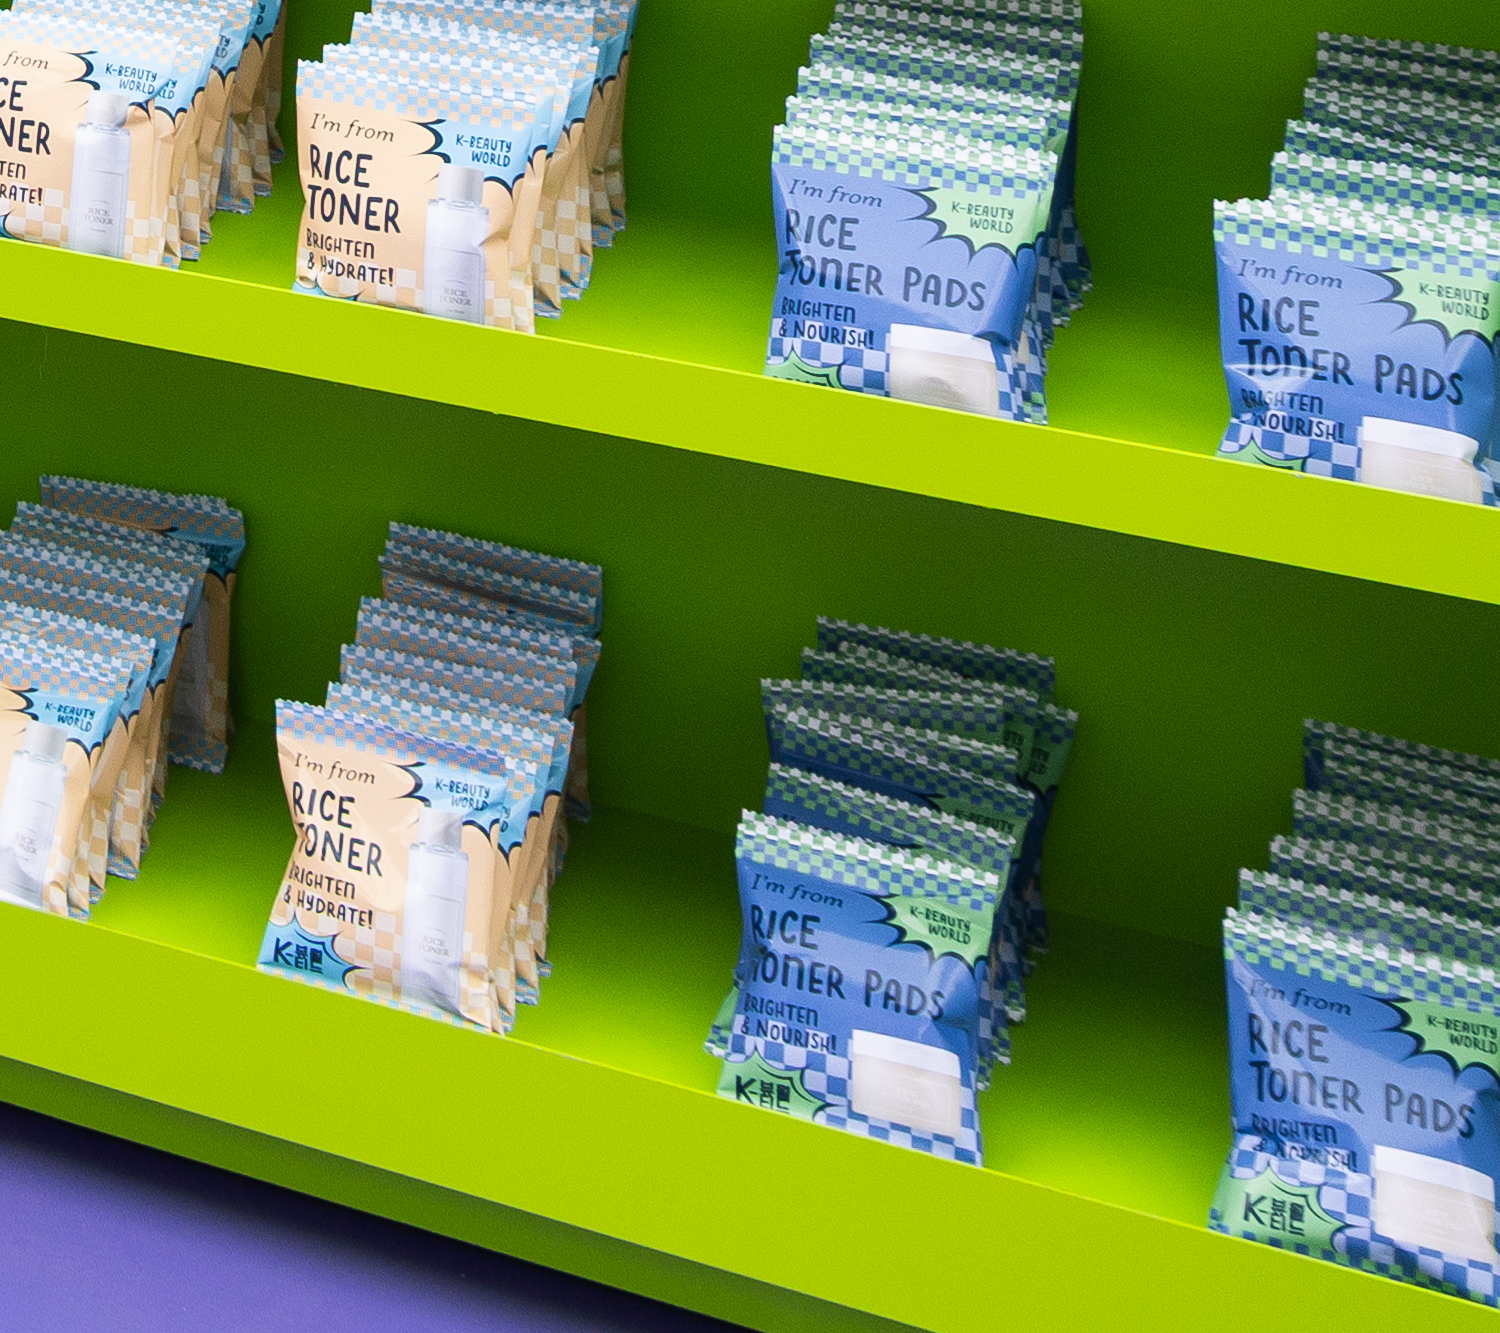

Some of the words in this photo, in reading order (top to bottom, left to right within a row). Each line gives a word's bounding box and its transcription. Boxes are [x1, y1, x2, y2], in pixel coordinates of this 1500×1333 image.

[344, 119, 394, 142] from
[456, 134, 512, 153] K-BEAUTY
[310, 144, 373, 188] RICE
[471, 151, 511, 167] WORLD
[307, 184, 401, 233] TONER
[307, 228, 375, 259] BRIGHTEN
[320, 256, 394, 286] HYDRATE!
[293, 781, 355, 829] RICE
[297, 890, 373, 929] HYDRATE!
[910, 906, 970, 931] K-BEAUTY
[752, 904, 821, 950] RICE
[928, 923, 970, 945] WORLD
[864, 969, 945, 1021] PADS
